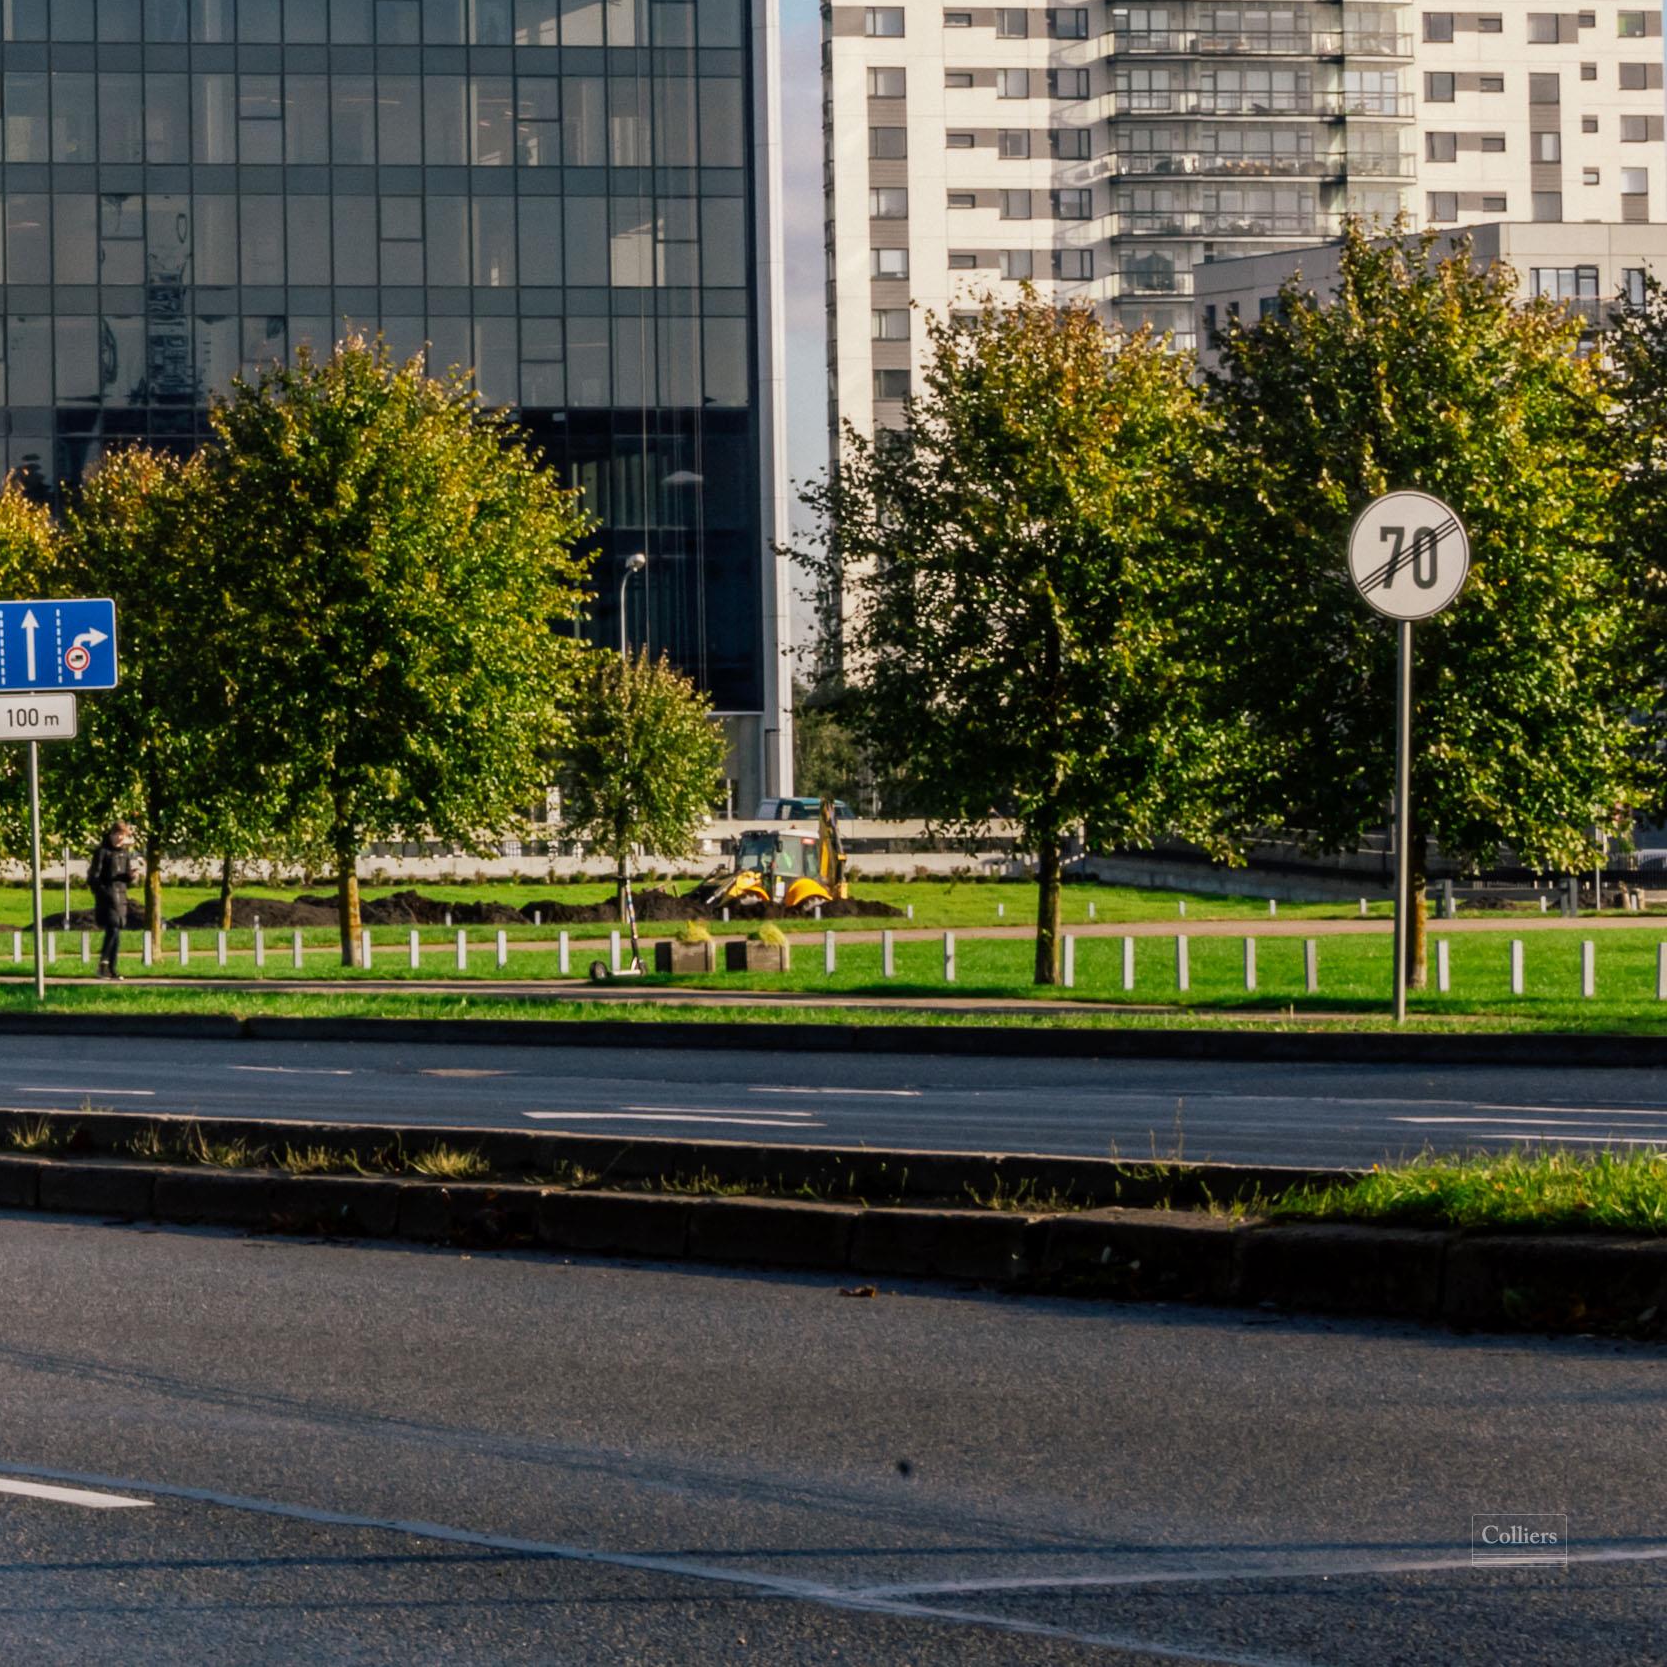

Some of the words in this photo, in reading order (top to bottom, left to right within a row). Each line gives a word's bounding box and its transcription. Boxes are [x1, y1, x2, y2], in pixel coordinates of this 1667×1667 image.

[1379, 525, 1438, 590] 70
[7, 707, 39, 728] 100
[44, 714, 60, 727] m
